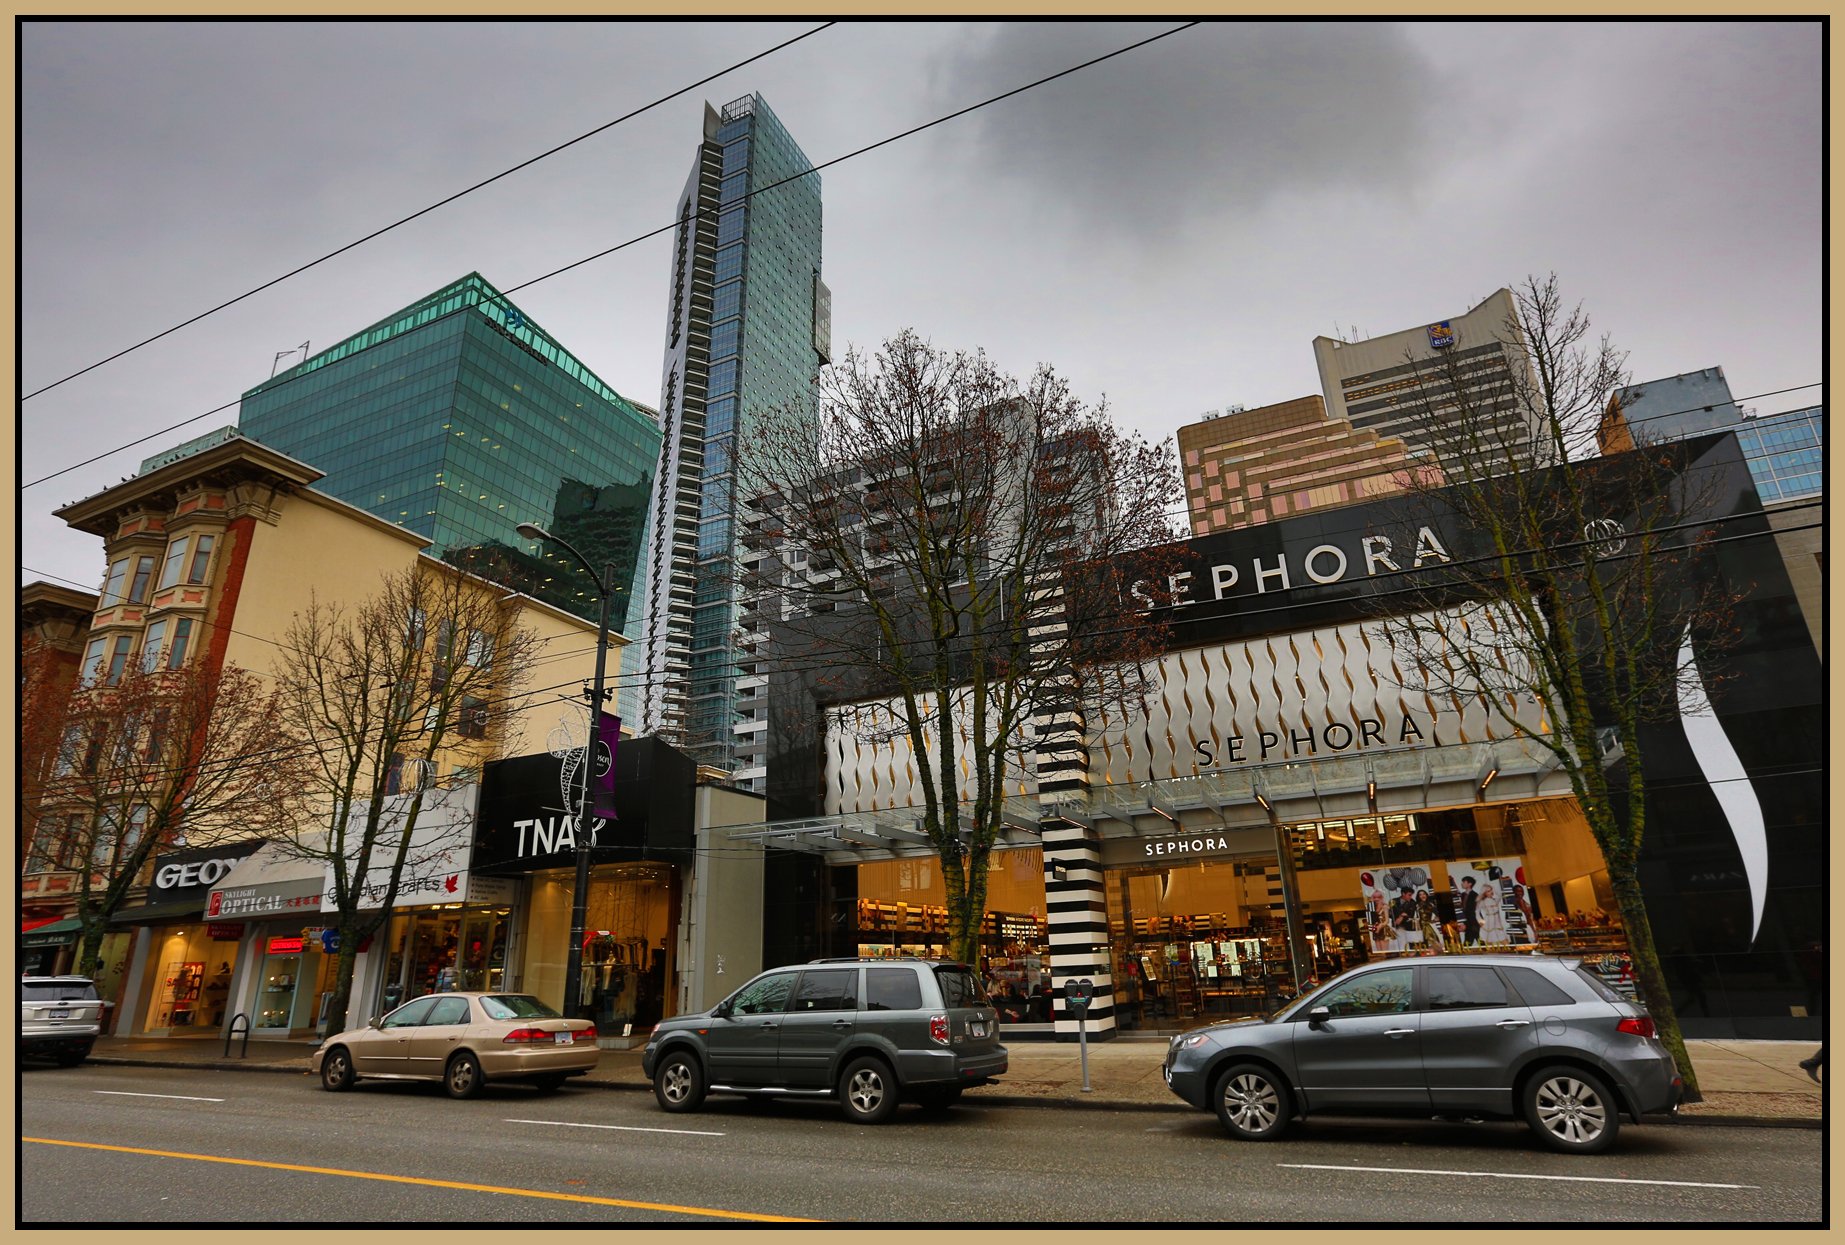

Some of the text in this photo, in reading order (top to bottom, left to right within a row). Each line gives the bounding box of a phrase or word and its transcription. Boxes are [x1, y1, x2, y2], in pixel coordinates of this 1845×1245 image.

[1434, 335, 1453, 346] RBC
[1131, 526, 1452, 613] SEPHORA
[1196, 714, 1424, 767] SEPHORA
[513, 815, 576, 858] TNA
[1145, 837, 1228, 856] SEPHORA
[225, 889, 256, 899] SKYLIGHT
[221, 895, 282, 914] OPTICAL
